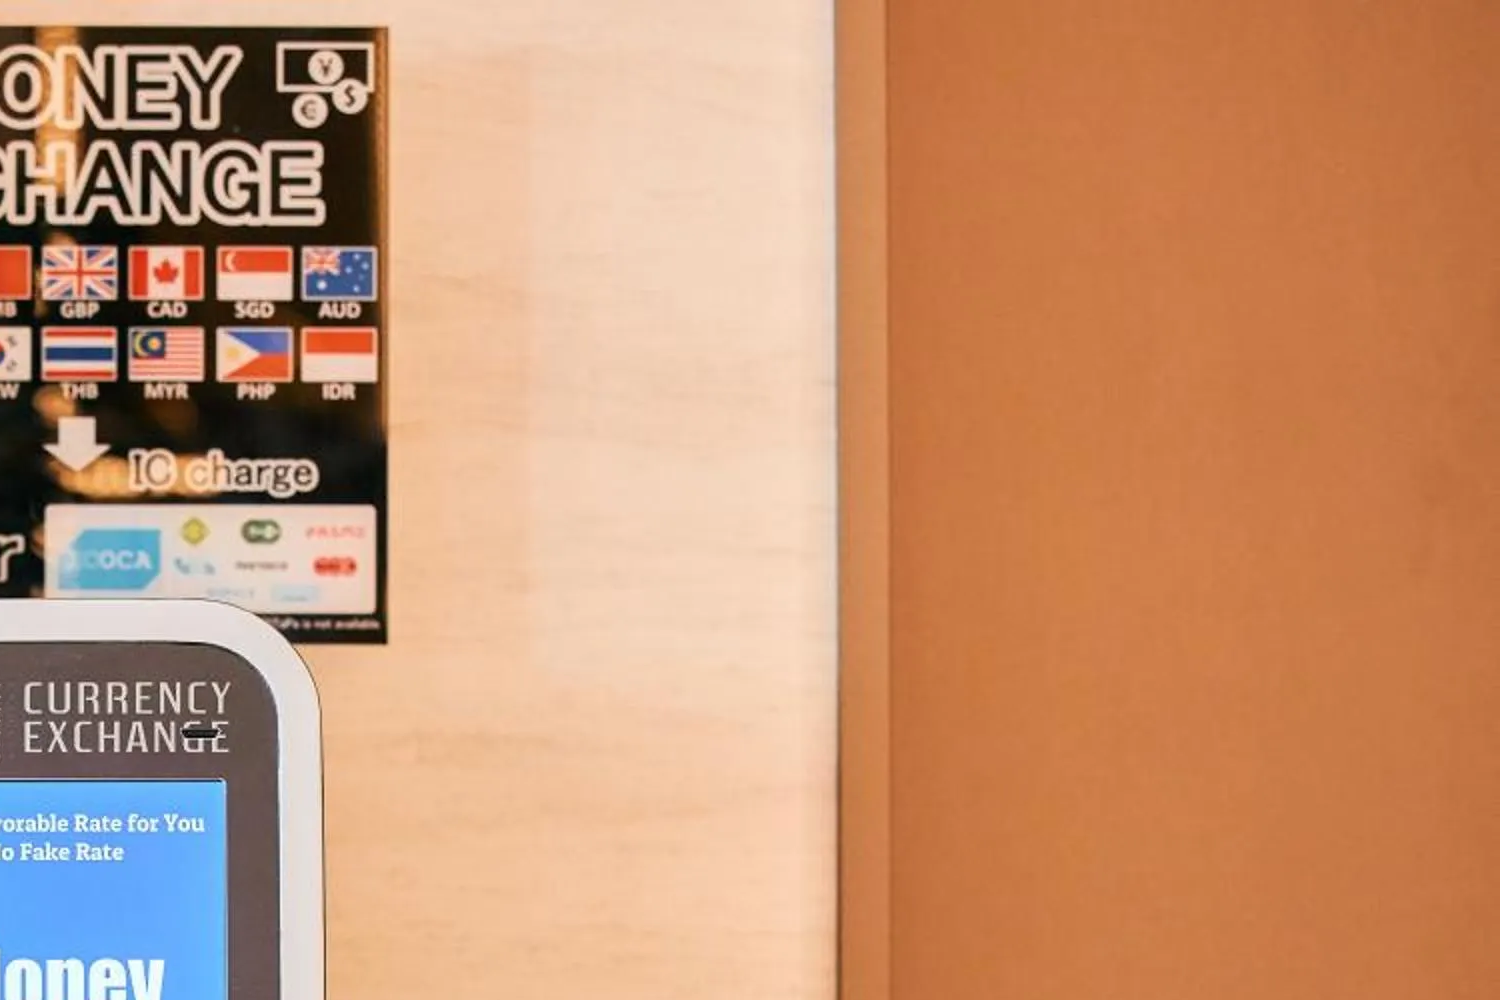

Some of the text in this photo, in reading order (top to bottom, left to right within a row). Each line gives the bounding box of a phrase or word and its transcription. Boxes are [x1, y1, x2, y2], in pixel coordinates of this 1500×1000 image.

[59, 301, 100, 319] GBP
[146, 301, 187, 319] CAD
[234, 301, 275, 319] SGD
[318, 301, 361, 319] AUD
[60, 383, 99, 400] THB
[144, 383, 189, 400] MYR
[237, 383, 275, 400] PHP
[323, 383, 355, 400] IDR
[128, 448, 319, 497] IC charge
[23, 681, 231, 715] CURRENCY
[23, 720, 230, 753] EXCHANGE
[74, 815, 121, 833] Rate
[127, 814, 158, 833] for
[163, 814, 205, 833] You
[19, 842, 69, 861] Fake
[75, 843, 124, 861] Rate
